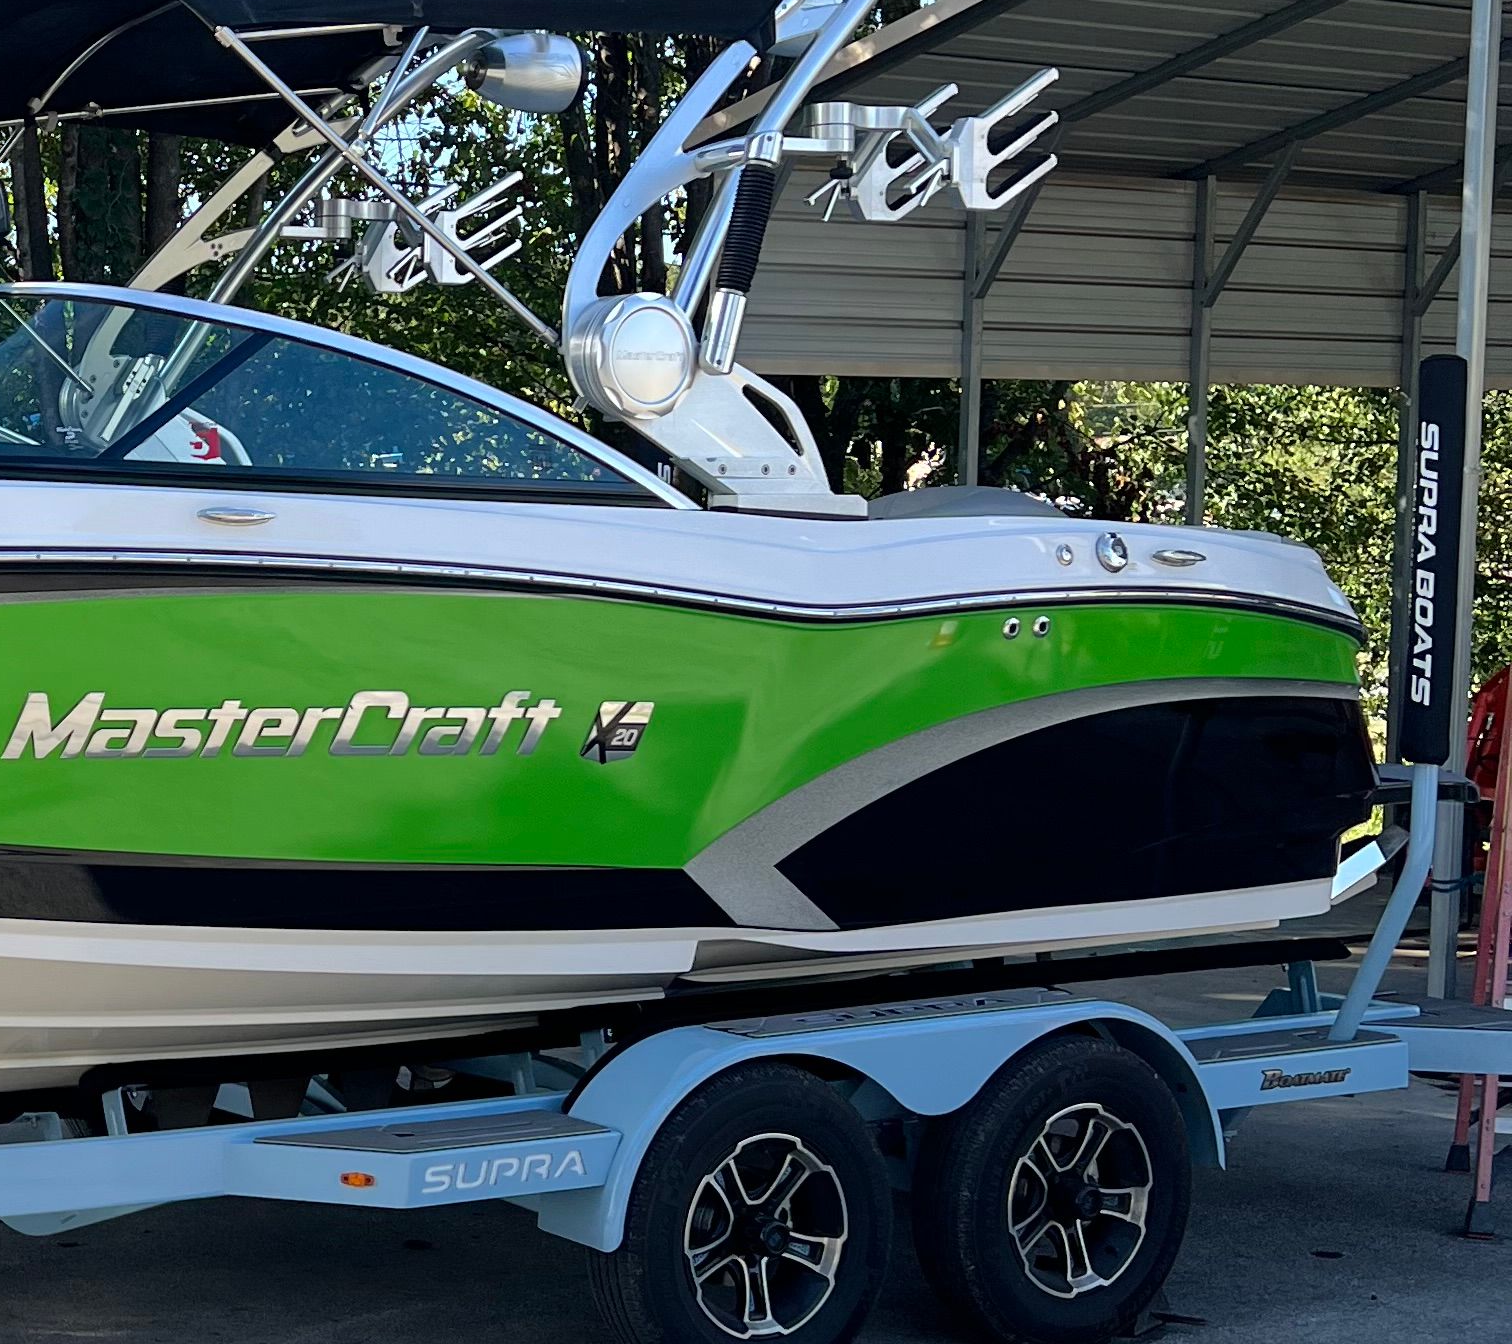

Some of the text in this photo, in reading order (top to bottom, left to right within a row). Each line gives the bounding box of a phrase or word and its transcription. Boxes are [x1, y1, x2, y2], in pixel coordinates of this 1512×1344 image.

[1410, 421, 1439, 706] SUPRA BOATS
[0, 690, 563, 759] MasterCraft
[421, 1150, 587, 1194] SUPRA
